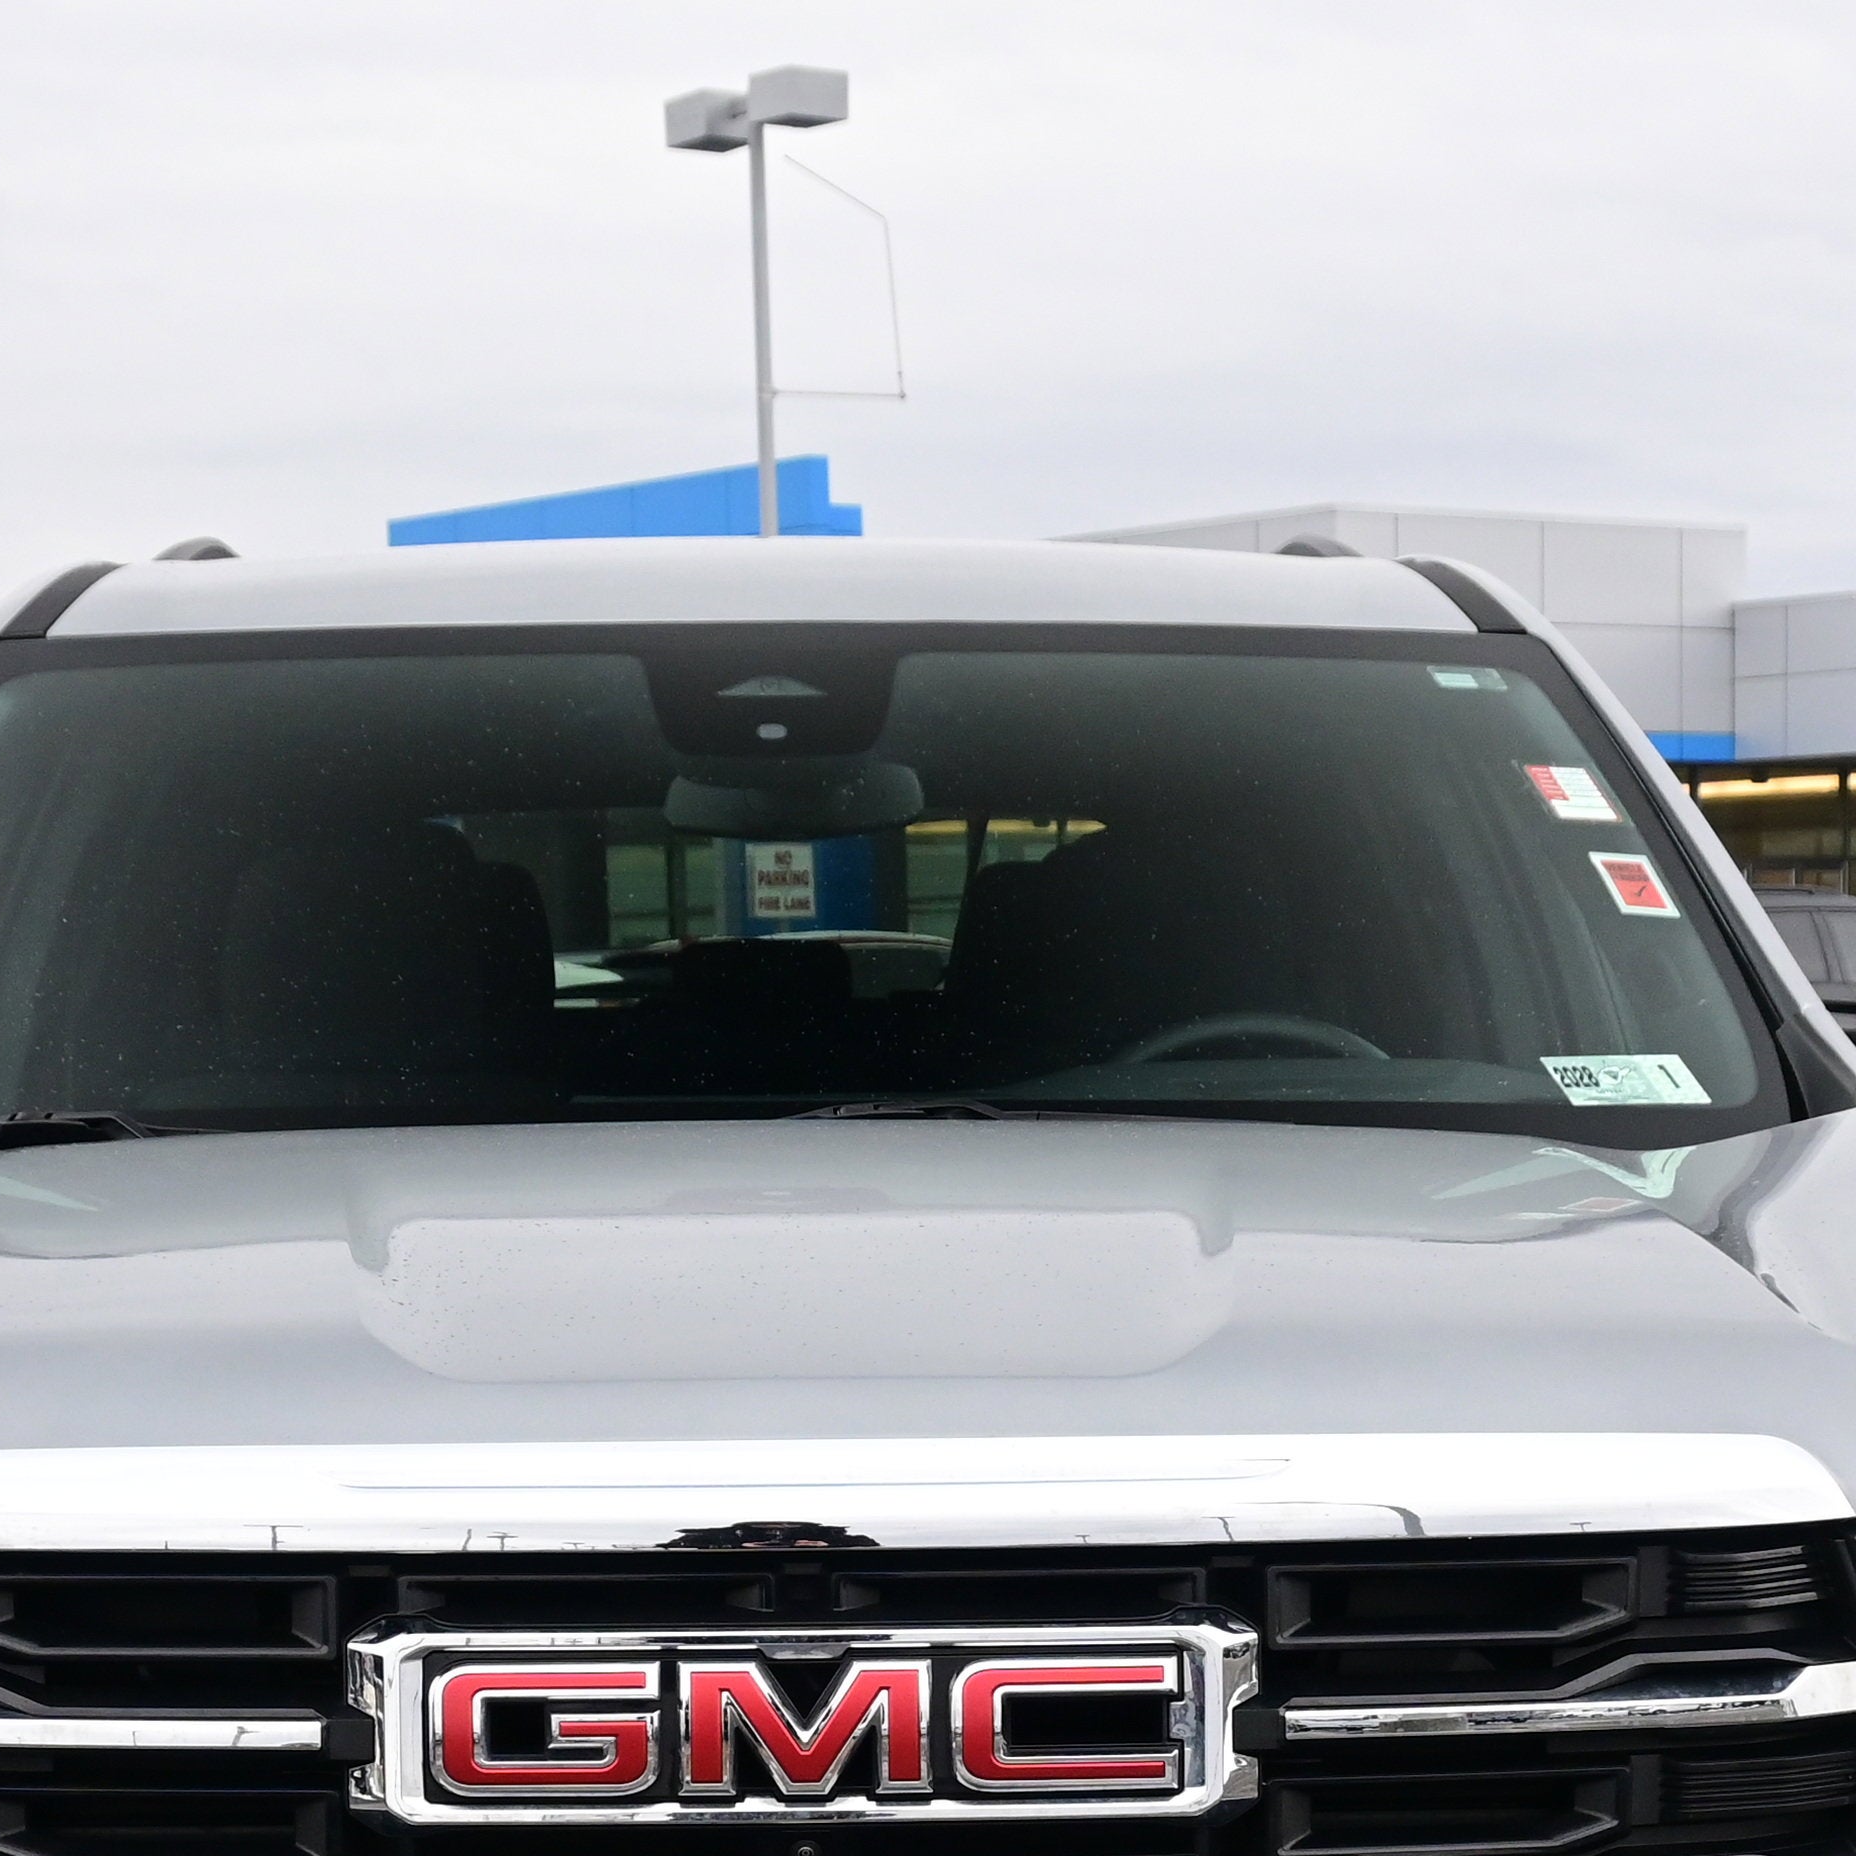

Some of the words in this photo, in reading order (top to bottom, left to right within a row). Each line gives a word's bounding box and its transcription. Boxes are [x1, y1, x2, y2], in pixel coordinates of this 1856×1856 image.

[774, 850, 792, 865] NO
[757, 869, 809, 887] PARKING
[783, 897, 811, 911] LANE
[1552, 1065, 1601, 1088] 2028
[427, 1657, 1179, 1797] GMC
